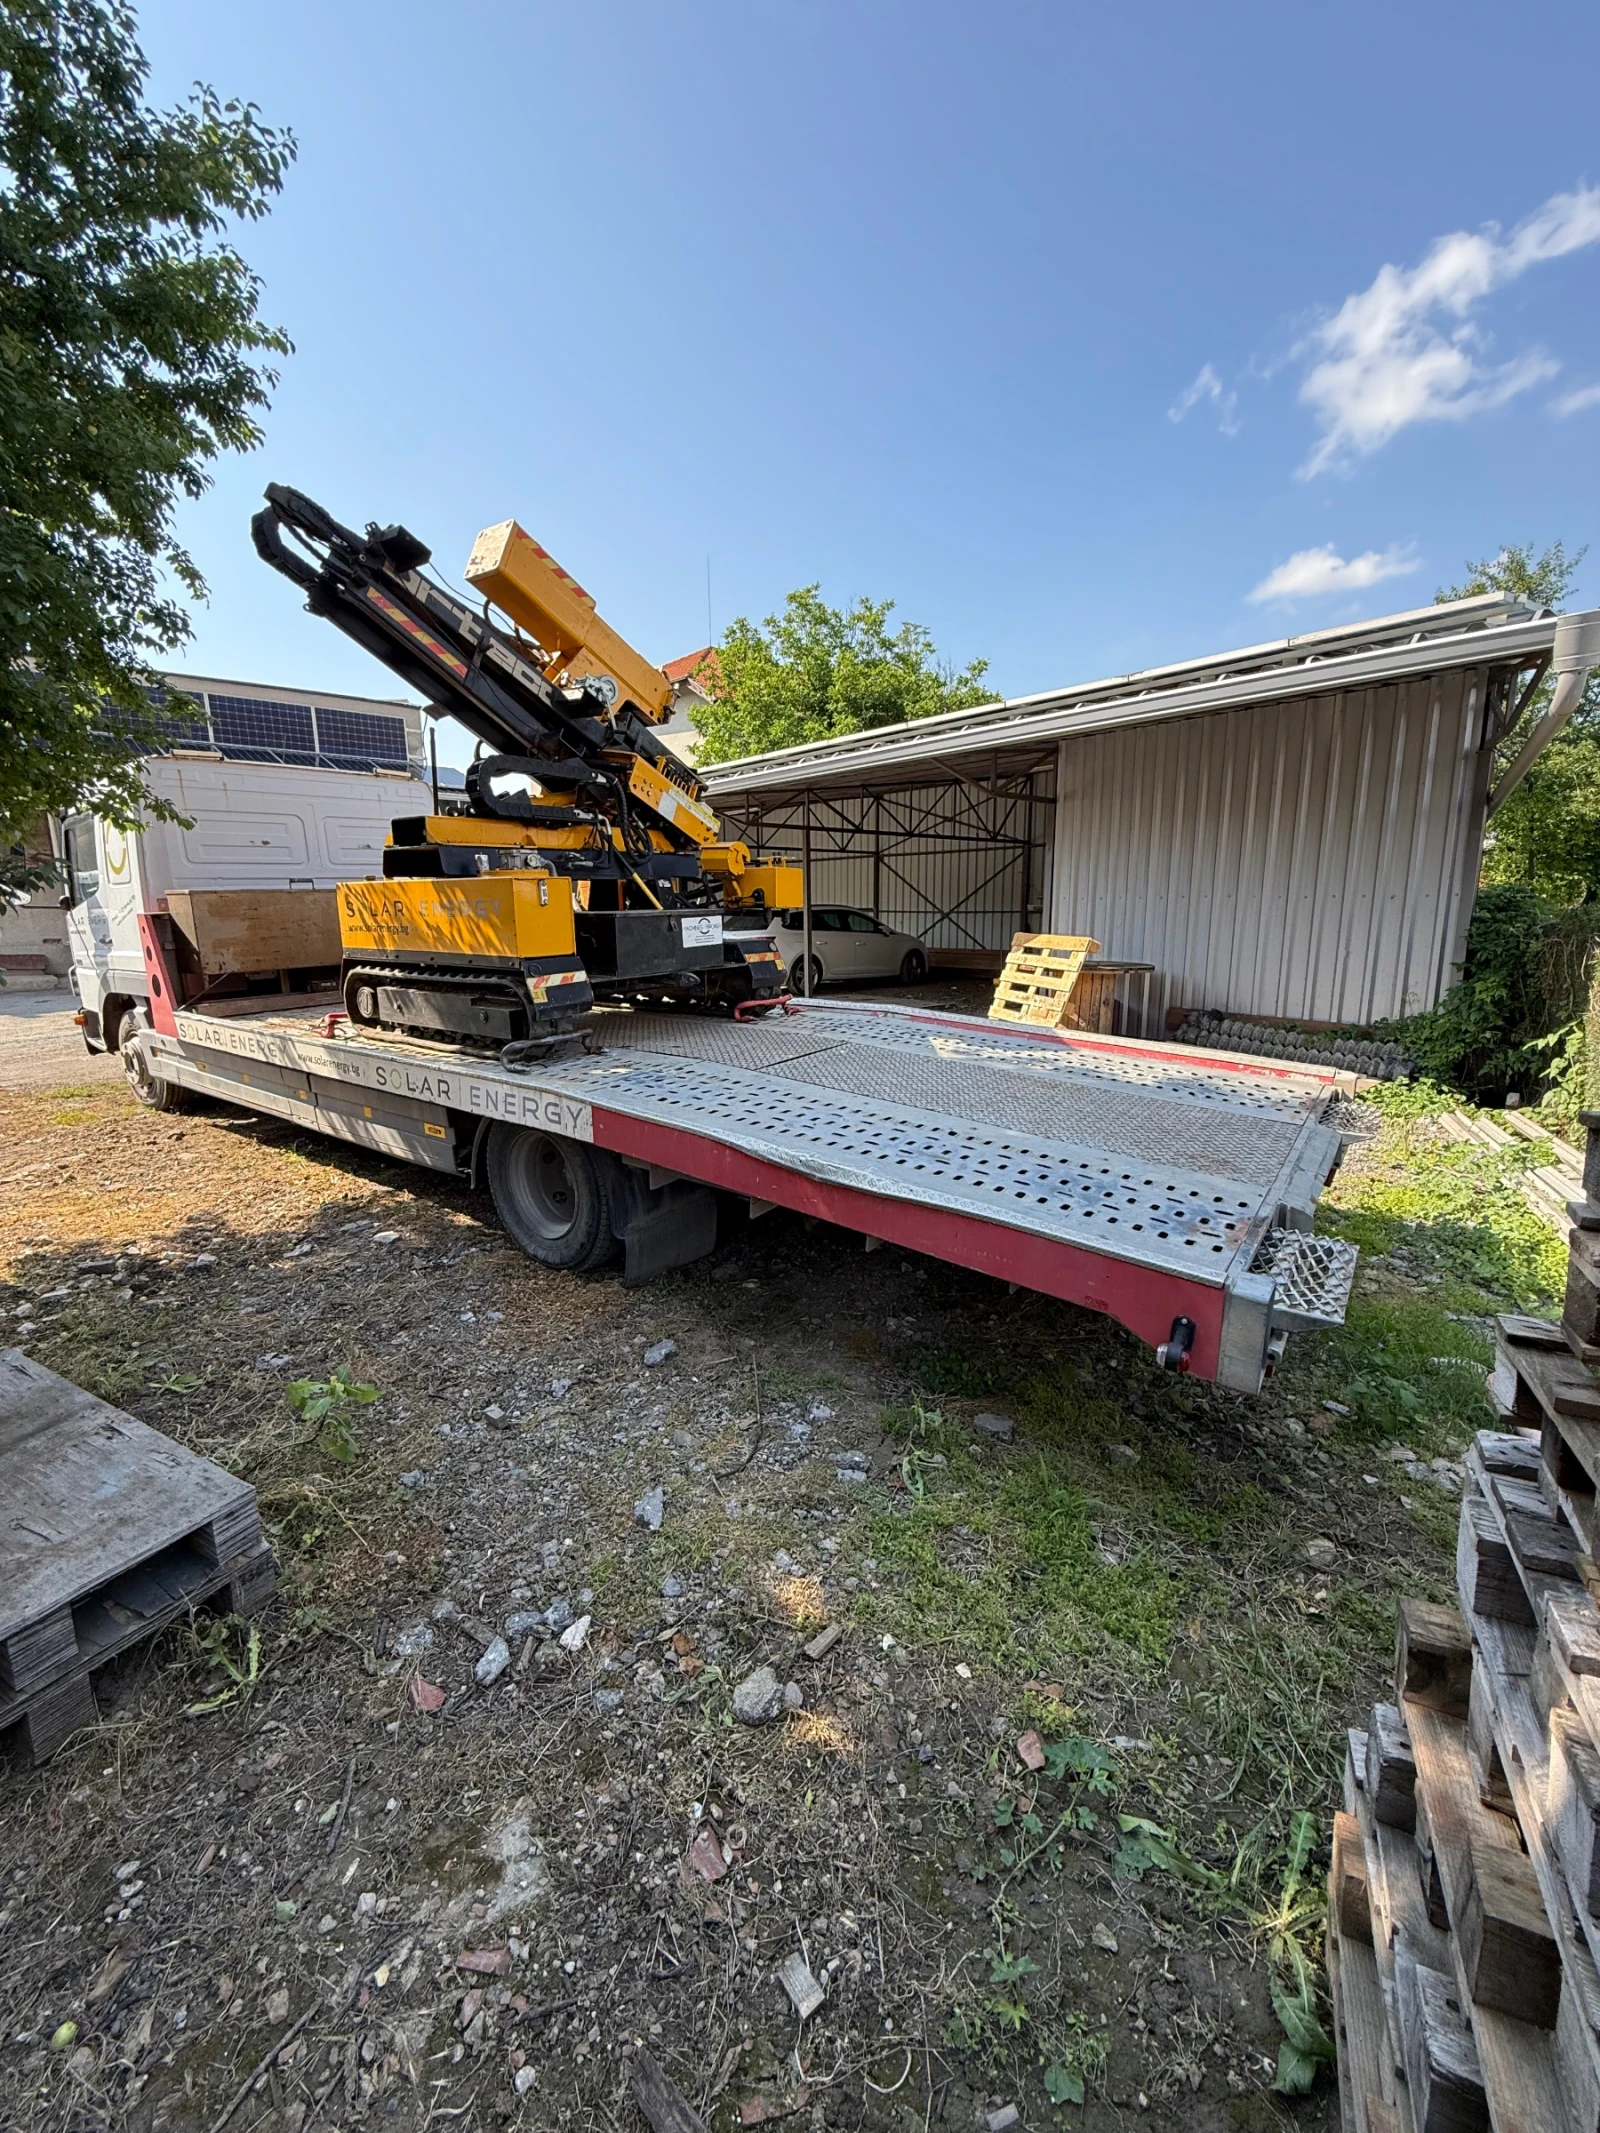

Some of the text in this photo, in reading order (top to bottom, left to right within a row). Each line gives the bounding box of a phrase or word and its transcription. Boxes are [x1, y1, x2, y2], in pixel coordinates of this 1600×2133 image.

[420, 899, 503, 919] ENERGY
[348, 922, 410, 936] www.solarenergy.bg
[179, 1022, 288, 1060] SOLAR ENERGY
[298, 1052, 361, 1077] www.solarenergy.bg
[375, 1065, 584, 1129] SOLAR ENERGY
